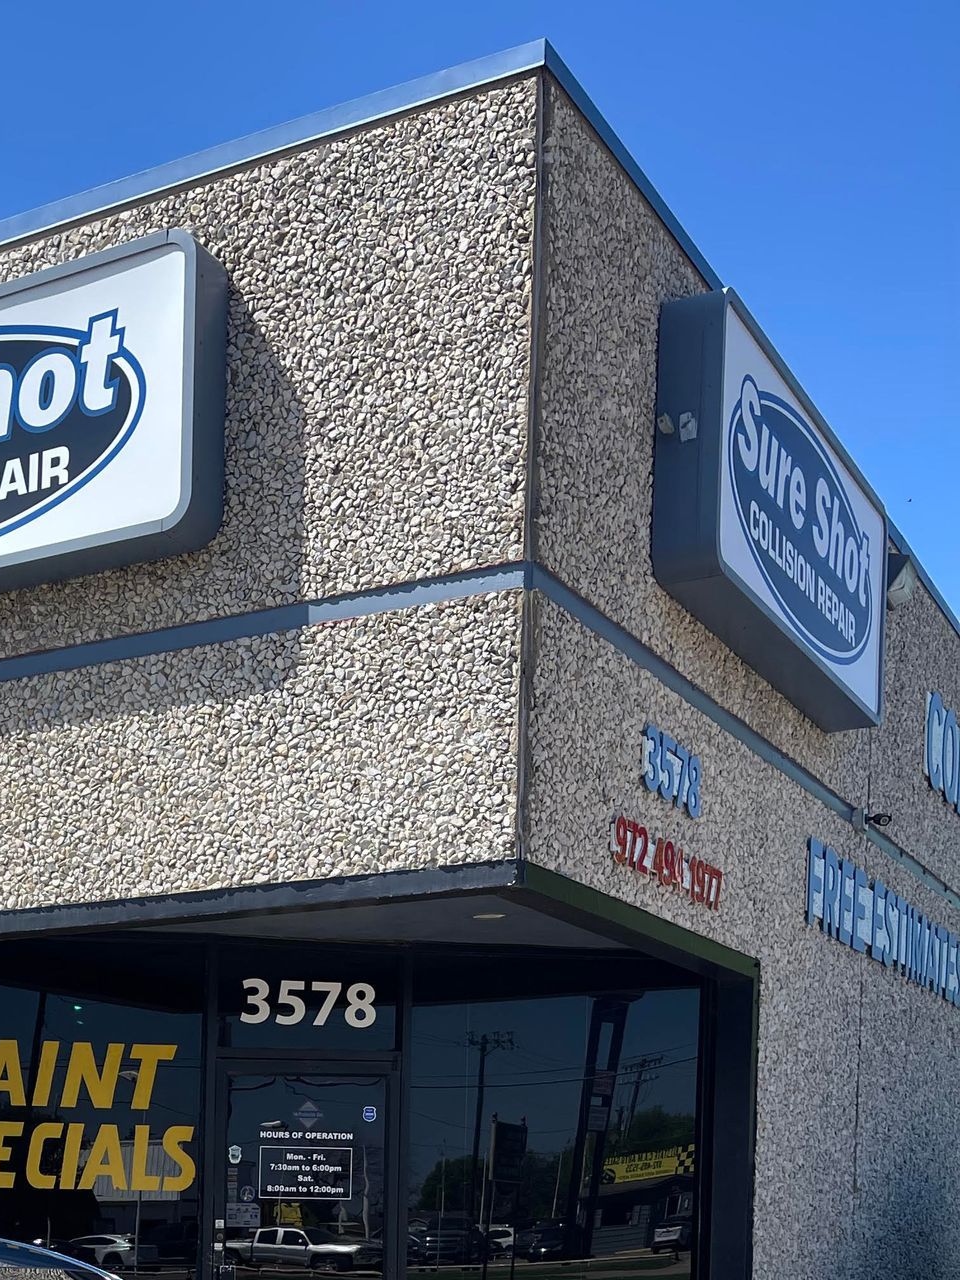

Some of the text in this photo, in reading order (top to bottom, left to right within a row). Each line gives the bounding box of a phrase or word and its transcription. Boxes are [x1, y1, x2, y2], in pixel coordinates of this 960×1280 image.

[738, 379, 872, 607] Sure Shot
[749, 500, 856, 648] COLLISION REPAIR
[644, 723, 702, 819] 3578
[927, 691, 960, 815] CO
[808, 835, 868, 955] FREE
[239, 977, 377, 1029] 3578
[259, 1131, 354, 1140] HOURS OF OPERATION
[269, 1163, 300, 1171] 7:30am
[312, 1164, 342, 1173] 6:00pm
[286, 1153, 306, 1161] Mon.
[312, 1153, 326, 1161] Fri.
[266, 1184, 297, 1192] 8:00am
[309, 1185, 344, 1194] 12:00pm
